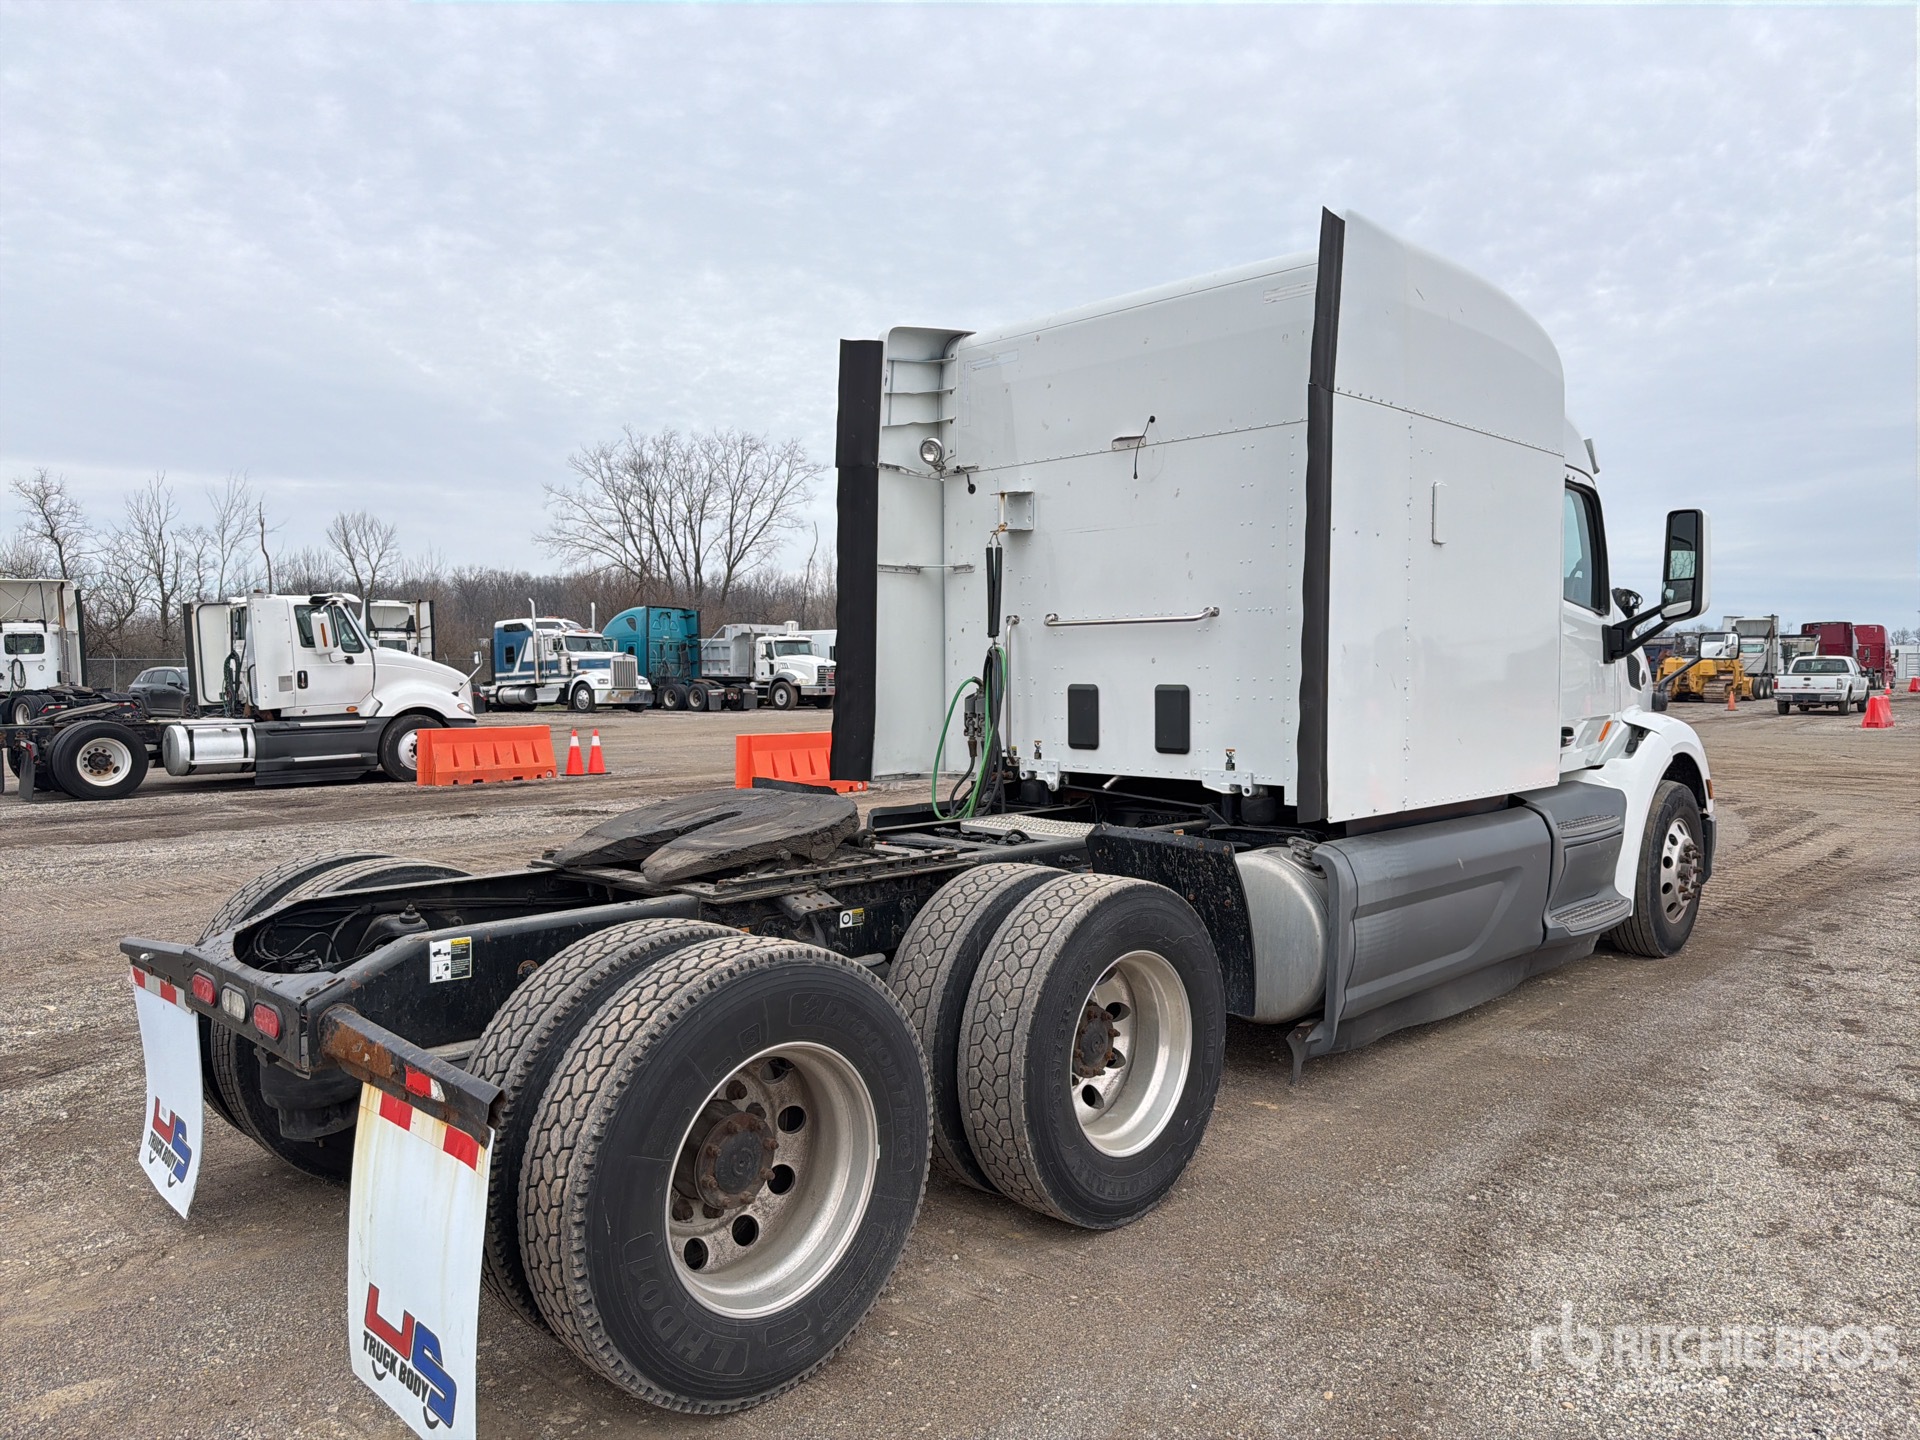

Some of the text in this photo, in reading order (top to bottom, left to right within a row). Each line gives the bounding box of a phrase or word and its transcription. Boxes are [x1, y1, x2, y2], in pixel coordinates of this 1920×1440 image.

[148, 1130, 178, 1171] TRUCK BODY
[152, 1095, 192, 1183] US
[363, 1330, 430, 1404] TRUCK BODY
[364, 1282, 457, 1429] US
